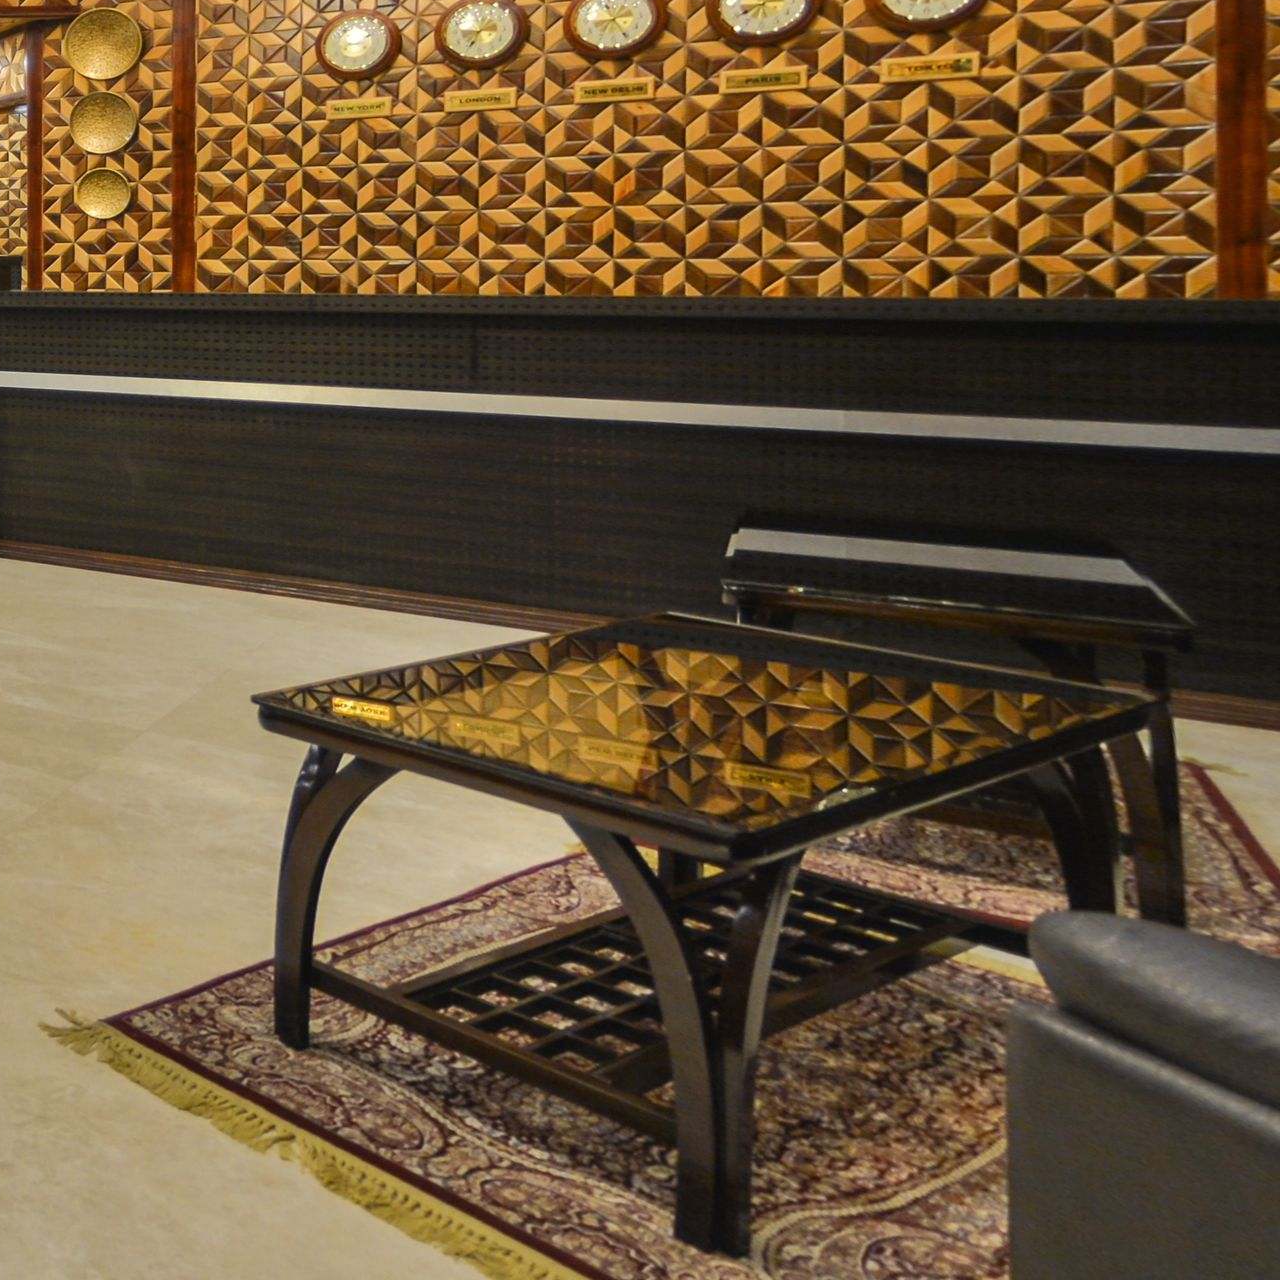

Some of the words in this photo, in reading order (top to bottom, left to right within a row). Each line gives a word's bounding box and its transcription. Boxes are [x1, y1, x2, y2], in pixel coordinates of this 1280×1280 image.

[907, 63, 953, 72] TOKYO
[745, 75, 782, 85] PARIS
[583, 87, 608, 96] NEW
[610, 85, 644, 94] DELHI
[459, 95, 502, 104] LONDON
[333, 105, 354, 113] NEW
[358, 103, 382, 111] YORK
